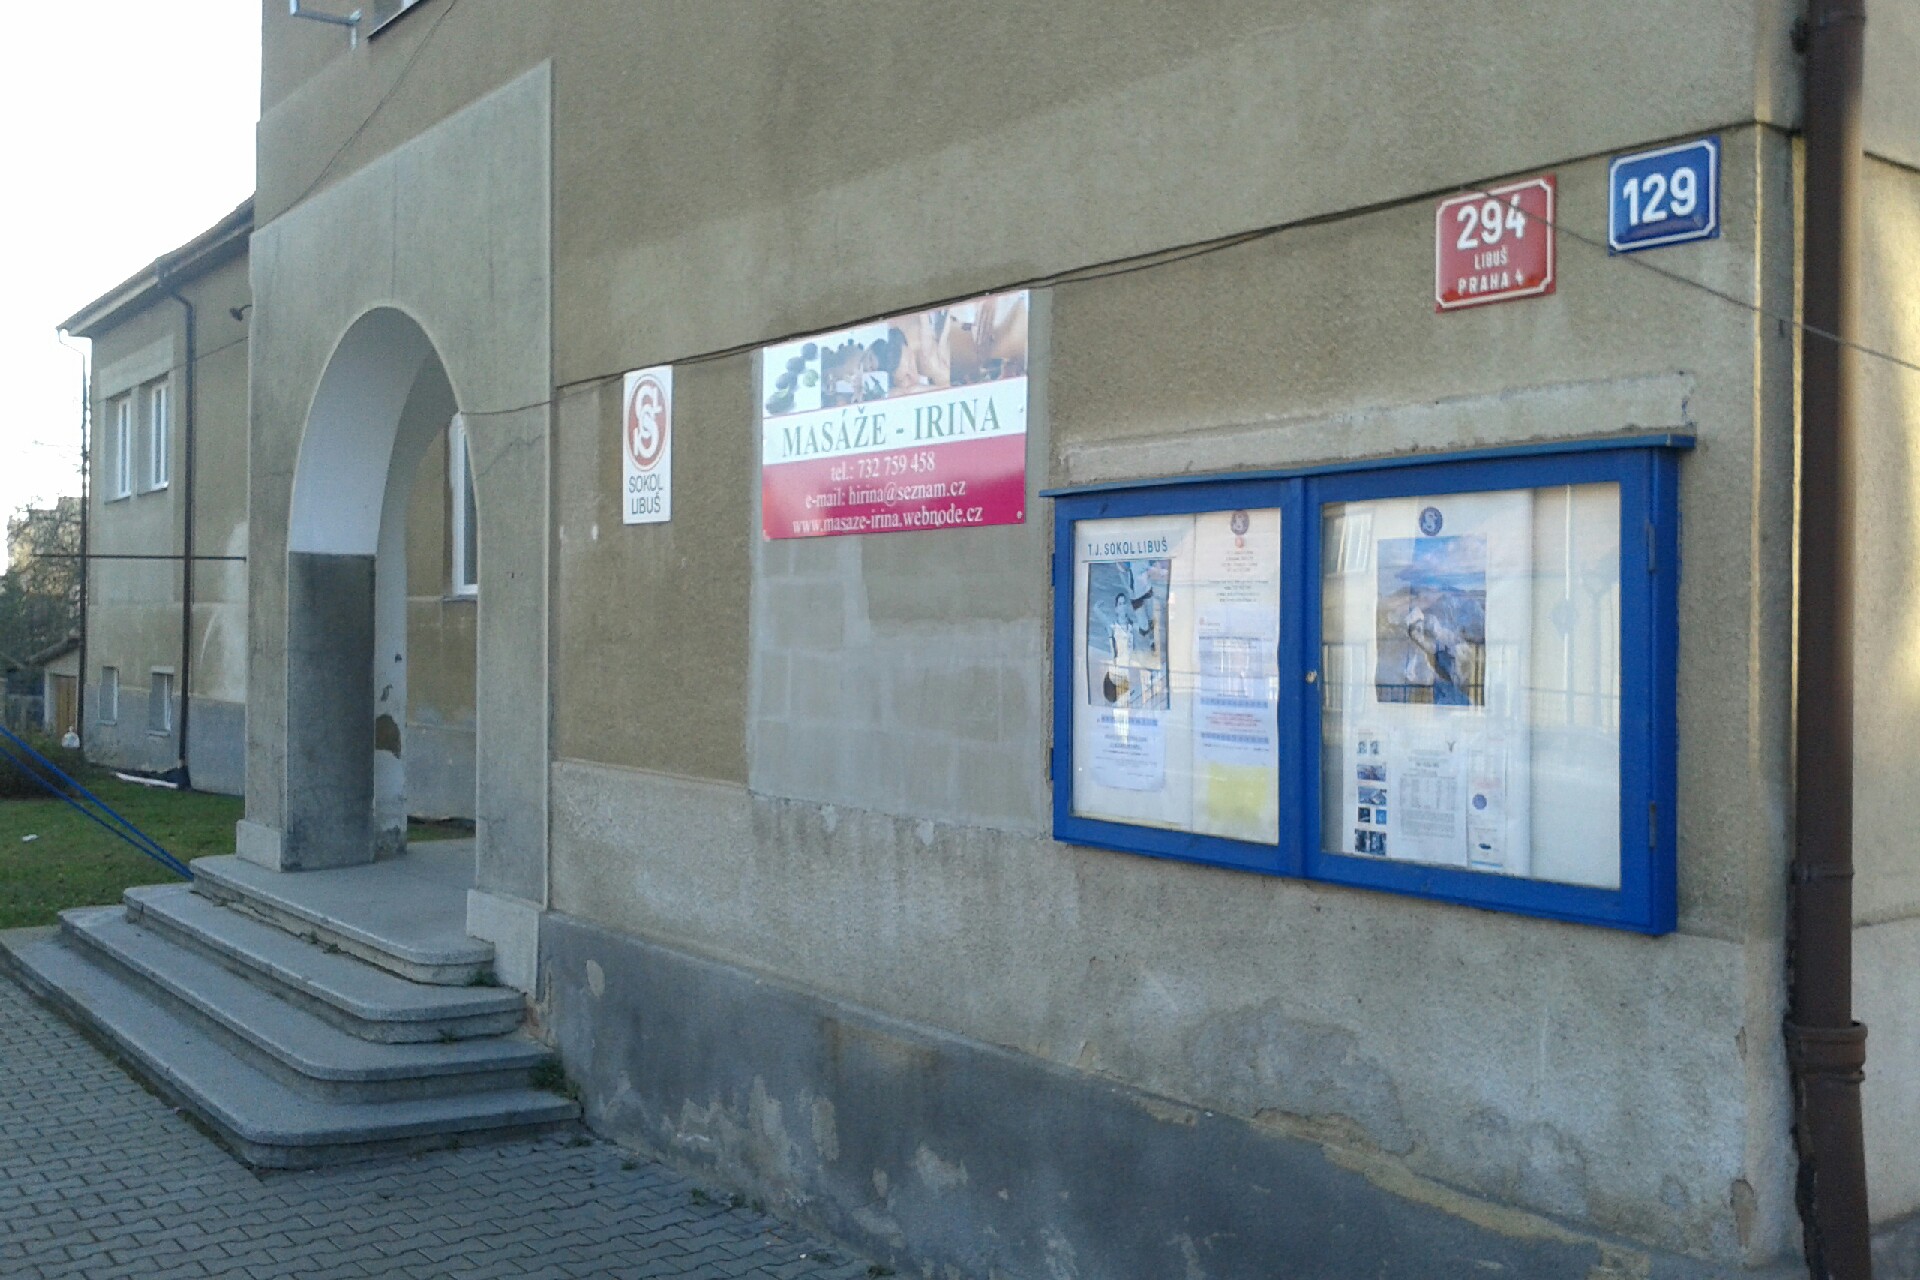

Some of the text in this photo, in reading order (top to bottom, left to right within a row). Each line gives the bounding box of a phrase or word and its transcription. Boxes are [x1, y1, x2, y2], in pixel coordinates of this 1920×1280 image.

[1623, 166, 1698, 225] 129
[1456, 194, 1526, 250] 294
[1474, 245, 1508, 270] LIBUŠ
[1457, 268, 1525, 296] PRAHA 4
[782, 405, 886, 458] MASÁŽE
[914, 396, 1001, 441] IRINA
[831, 451, 936, 482] tel.: 732 759 458
[628, 473, 664, 494] SOKOL
[631, 492, 661, 515] LIBUŠ
[805, 487, 845, 509] e-mail:
[793, 503, 983, 534] www.masaze-irina.webnode.cz
[1104, 541, 1135, 556] SOKOL
[1138, 537, 1168, 554] LIBUŠ
